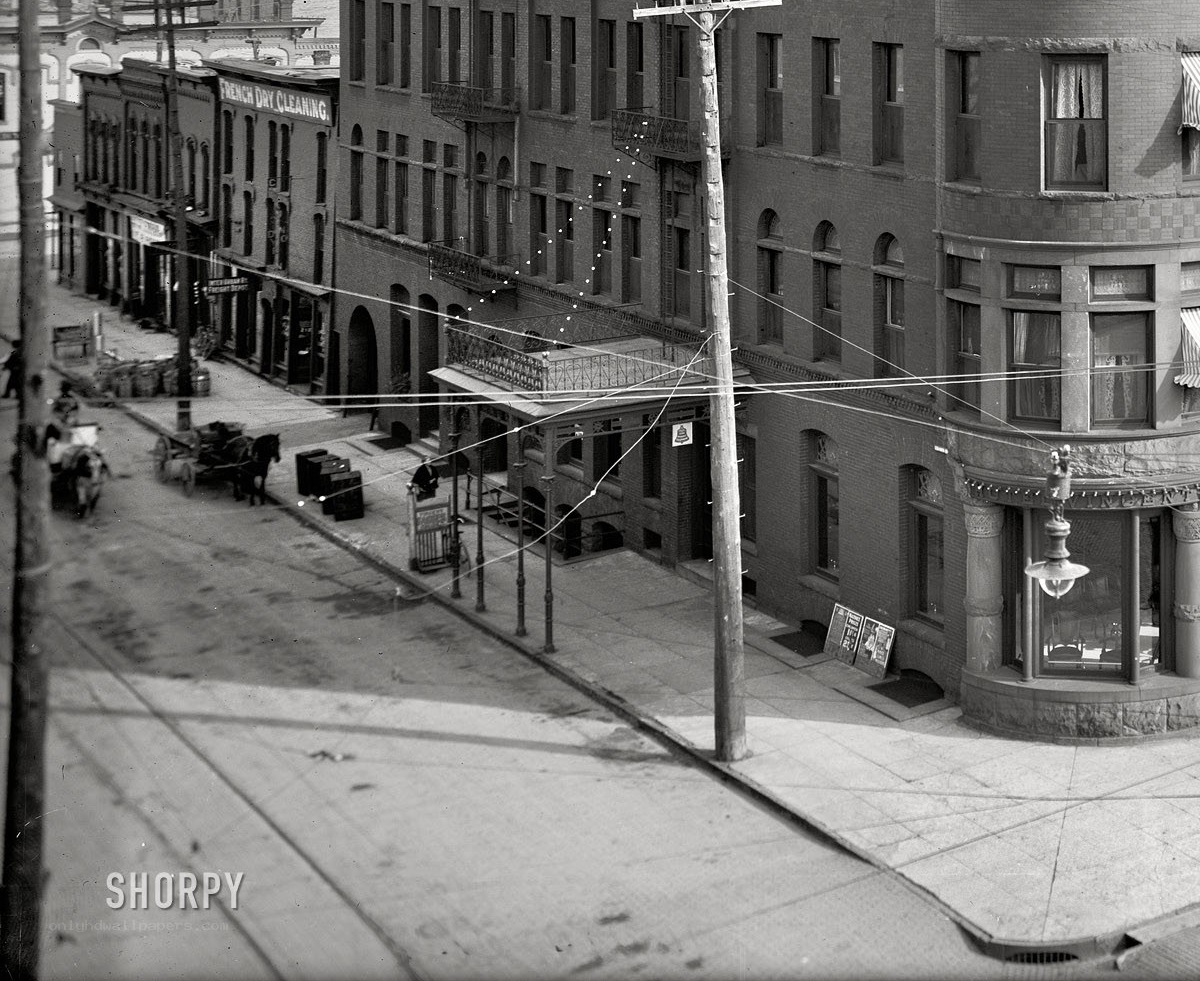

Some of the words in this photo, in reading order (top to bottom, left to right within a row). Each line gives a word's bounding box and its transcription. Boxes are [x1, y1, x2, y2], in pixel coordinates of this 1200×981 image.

[219, 77, 254, 105] FRENCH
[254, 86, 274, 109] DRY
[275, 90, 330, 121] CLEANING.
[1068, 485, 1197, 508] VINCENT
